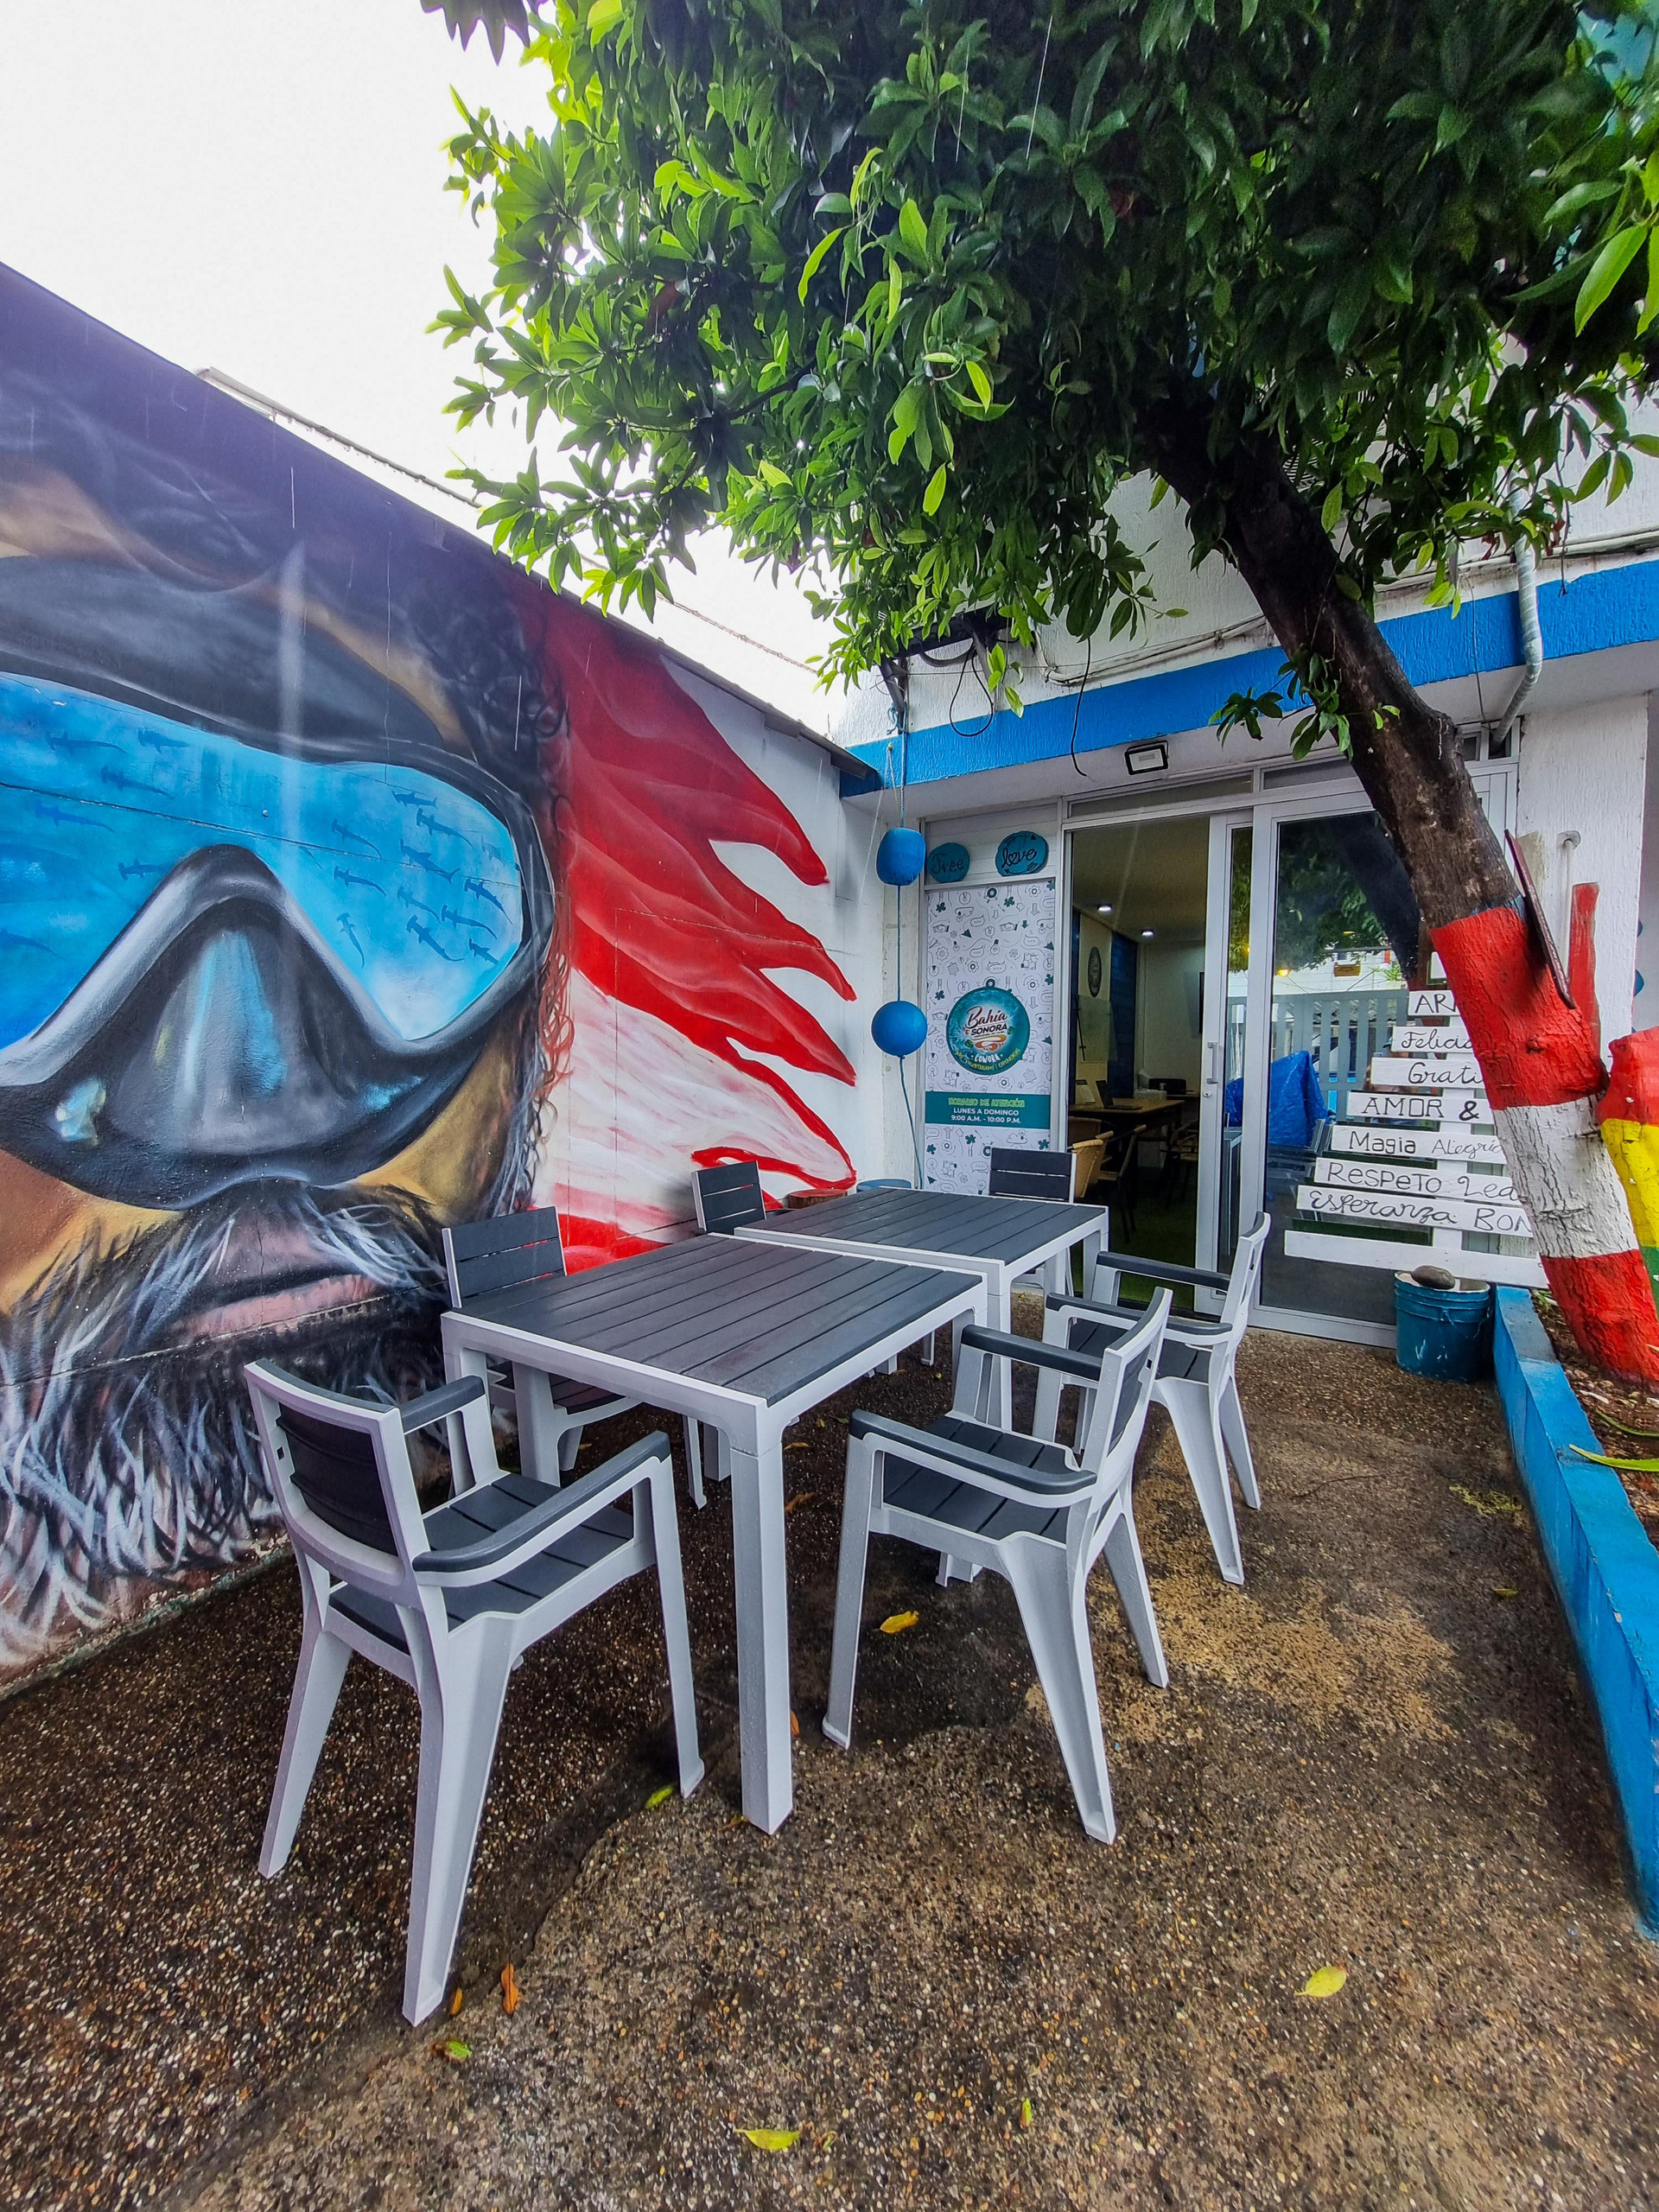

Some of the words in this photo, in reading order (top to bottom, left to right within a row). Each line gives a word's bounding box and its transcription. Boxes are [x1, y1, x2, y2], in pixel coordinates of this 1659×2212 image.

[931, 852, 964, 874] Free
[1414, 993, 1456, 1014] AR
[965, 1005, 1007, 1029] Bahía
[970, 1023, 1007, 1036] SONORA
[1408, 1061, 1483, 1084] Grati
[980, 1098, 990, 1107] DE
[1361, 1096, 1445, 1118] AMOR
[1459, 1100, 1479, 1122] &
[1349, 1131, 1416, 1154] Magia
[1458, 1175, 1518, 1201] Lea
[1309, 1190, 1458, 1224] Esperanza
[1474, 1207, 1532, 1233] BON
